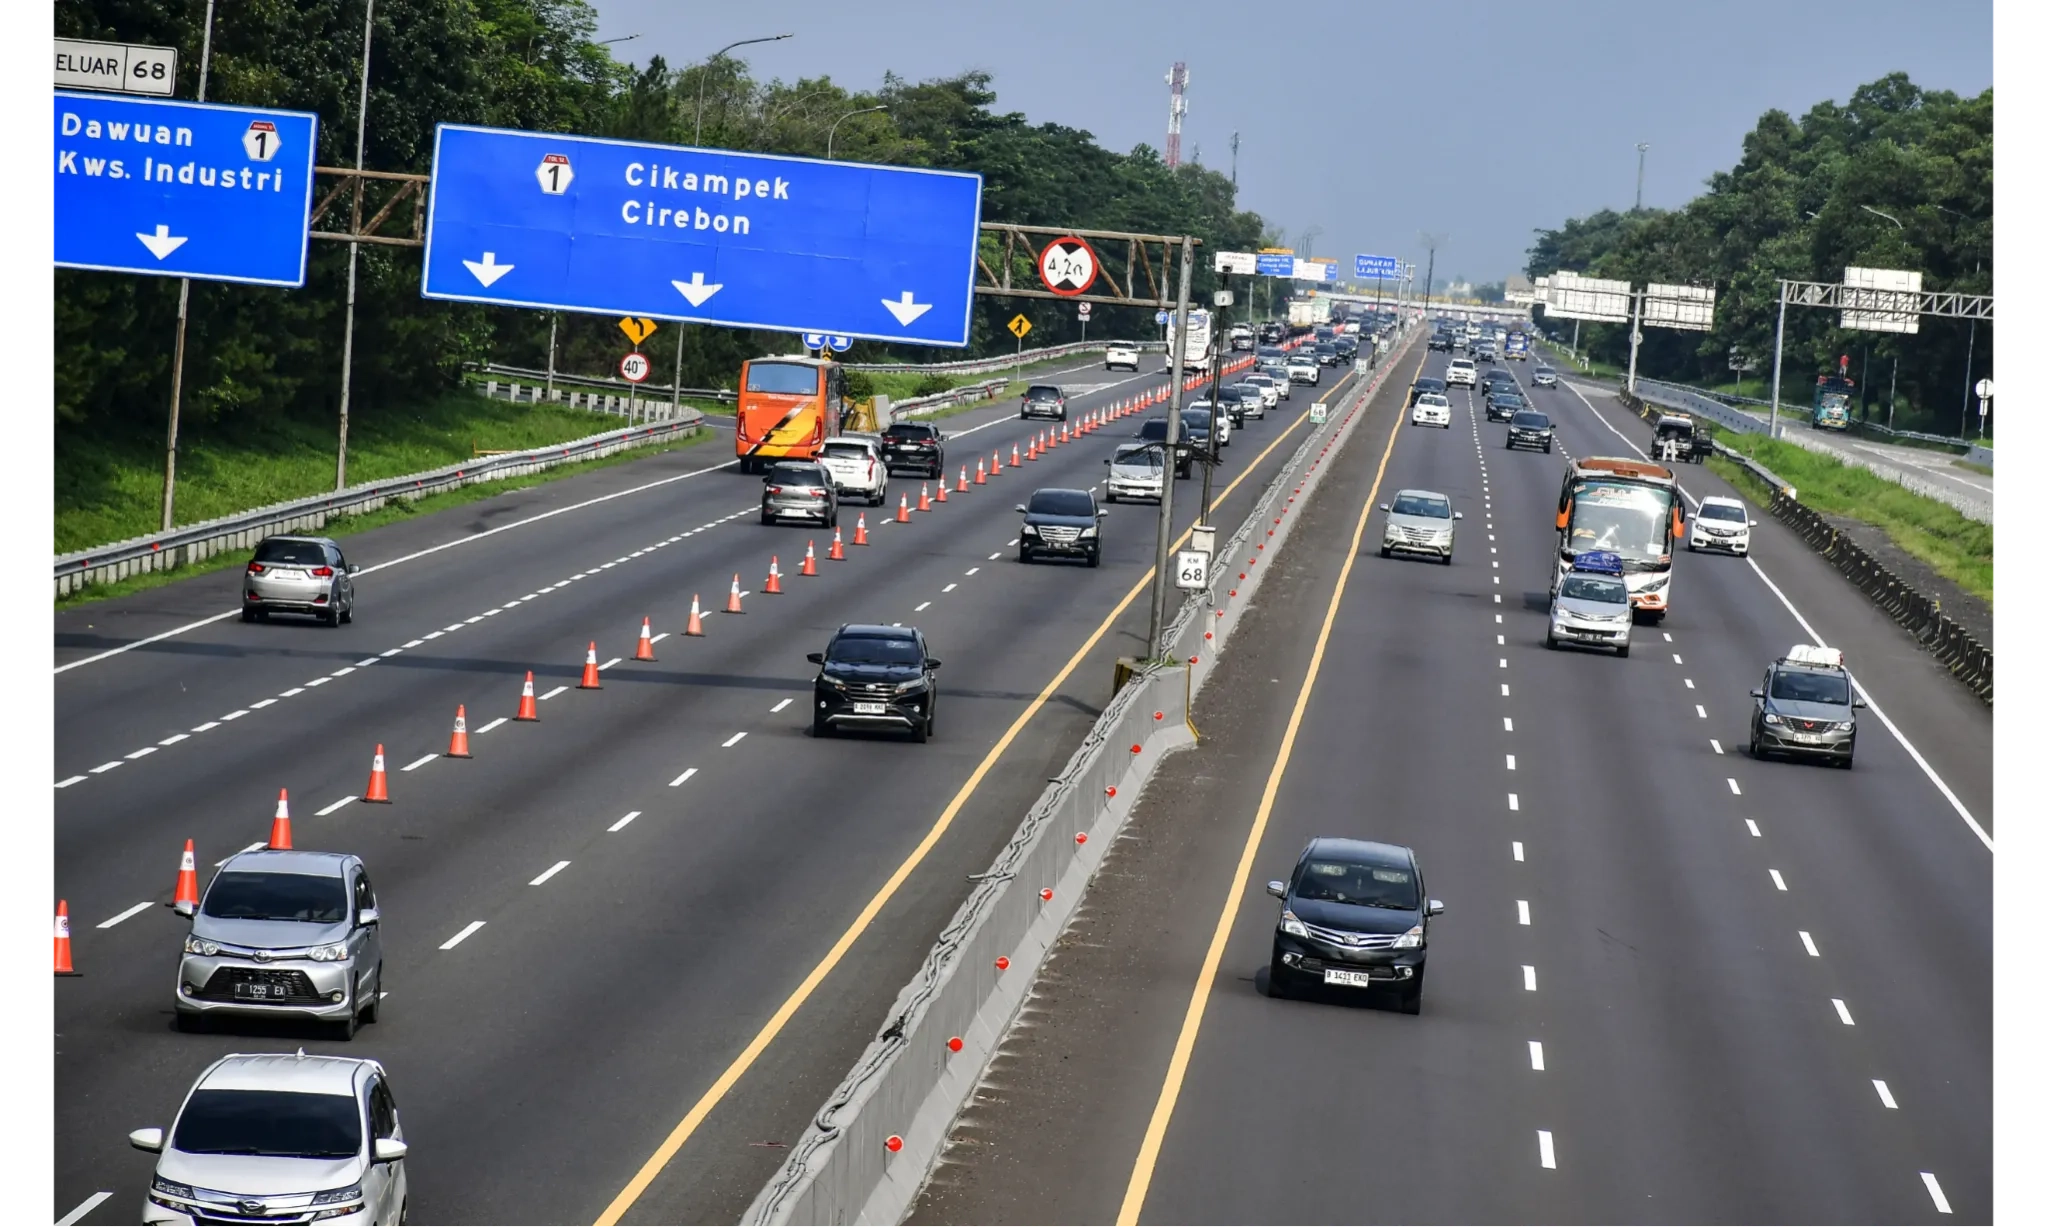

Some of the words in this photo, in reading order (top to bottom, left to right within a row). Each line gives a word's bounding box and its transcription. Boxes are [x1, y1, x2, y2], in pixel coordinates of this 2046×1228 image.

[53, 53, 119, 76] ELUAR
[133, 60, 166, 80] 68
[61, 112, 193, 147] Dawuan
[254, 131, 267, 159] 1
[58, 150, 131, 179] Kws.
[144, 157, 282, 193] Industri
[548, 165, 559, 191] 1
[625, 162, 790, 201] Cikampek
[621, 200, 750, 235] Cirebon
[1181, 568, 1202, 581] 68
[236, 984, 242, 992] T
[250, 985, 267, 994] 1255
[275, 986, 284, 995] EX
